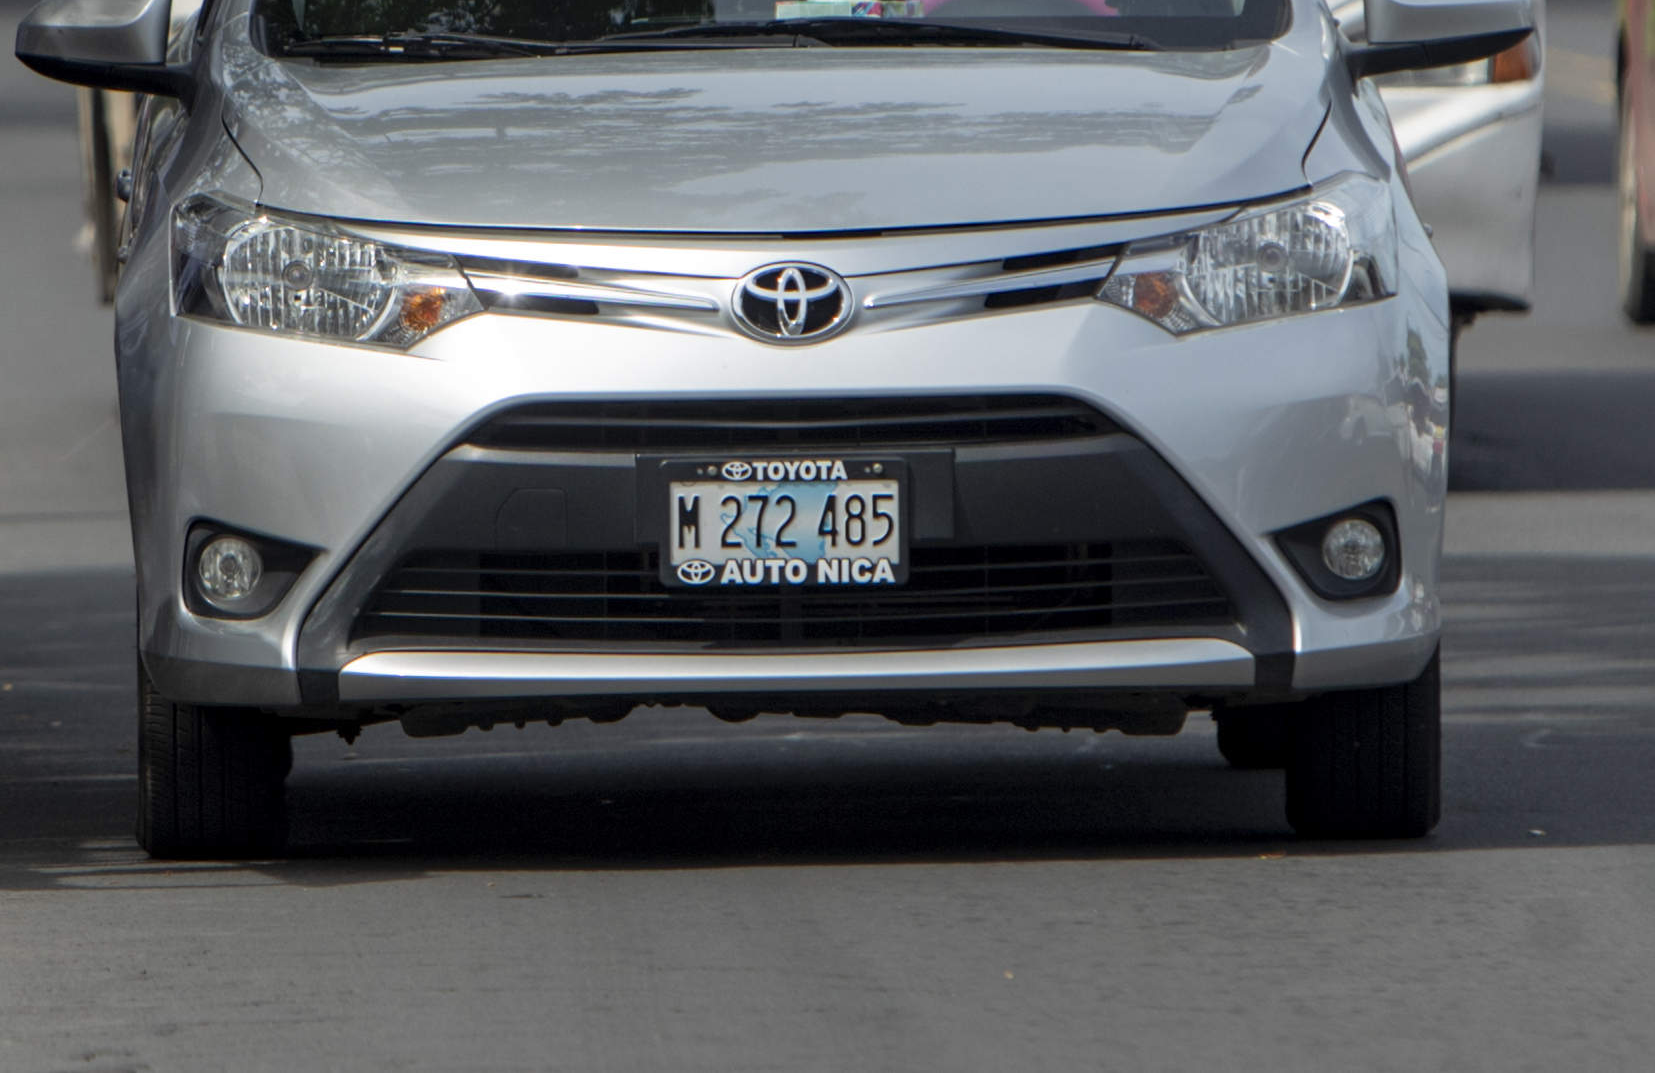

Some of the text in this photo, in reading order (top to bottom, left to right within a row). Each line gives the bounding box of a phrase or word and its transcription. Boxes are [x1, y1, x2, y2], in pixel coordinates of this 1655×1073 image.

[751, 461, 848, 480] TOYOTA
[677, 494, 894, 549] M 272 485
[720, 558, 896, 584] AUTO NICA
